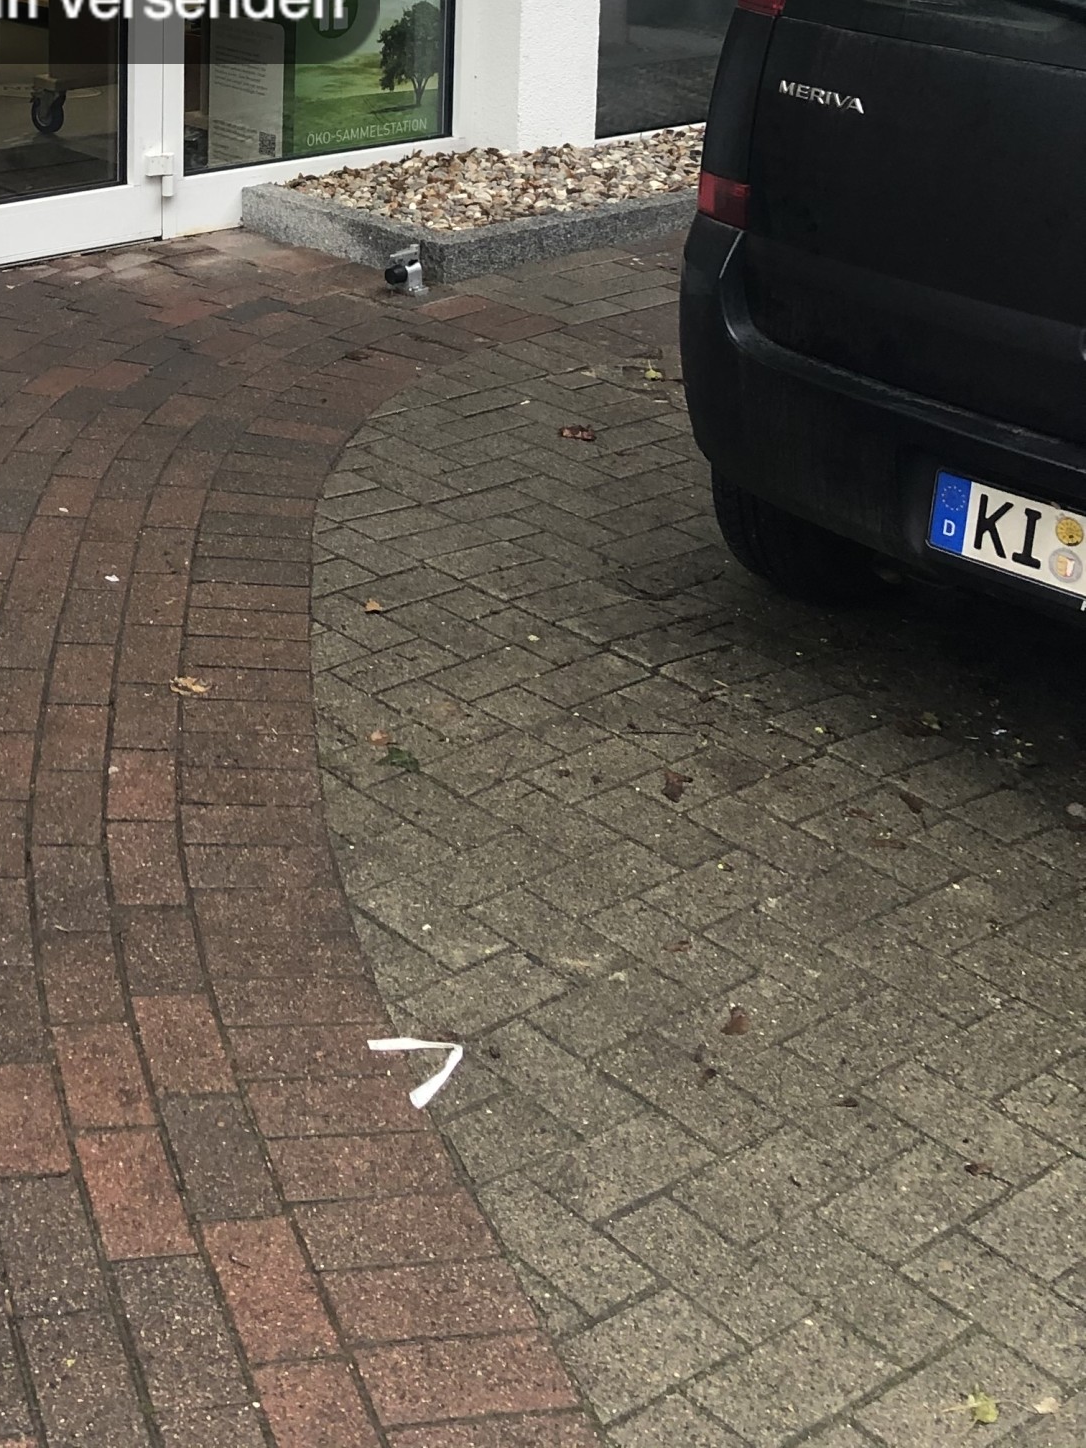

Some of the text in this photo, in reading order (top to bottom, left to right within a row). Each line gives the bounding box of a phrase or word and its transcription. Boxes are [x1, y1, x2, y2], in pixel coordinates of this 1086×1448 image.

[779, 80, 864, 114] MERIVA
[306, 118, 428, 147] ÖKO-SAMMELSTATION
[942, 493, 1042, 569] D KI
